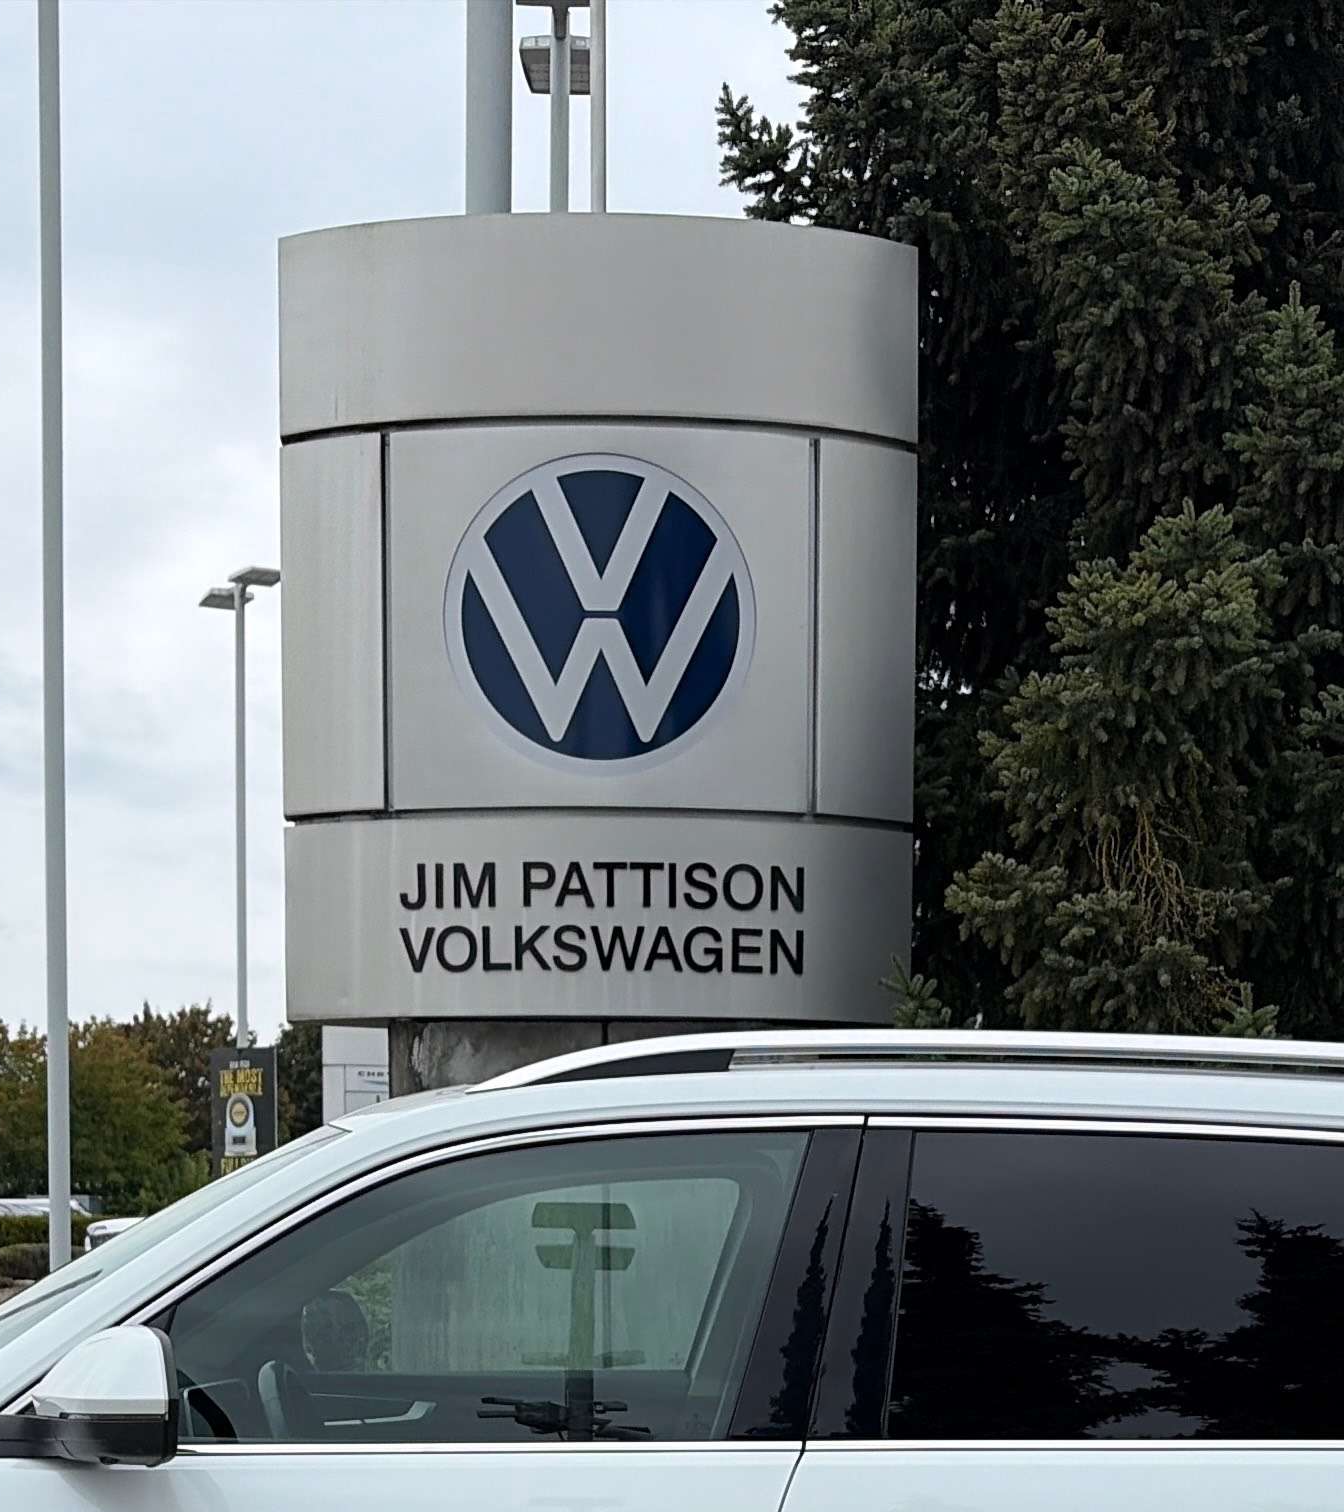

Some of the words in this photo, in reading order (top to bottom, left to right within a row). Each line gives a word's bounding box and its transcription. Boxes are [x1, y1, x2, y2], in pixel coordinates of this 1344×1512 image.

[399, 862, 497, 911] JIM
[522, 861, 806, 913] PATTISON
[399, 925, 806, 975] VOLKSWAGEN
